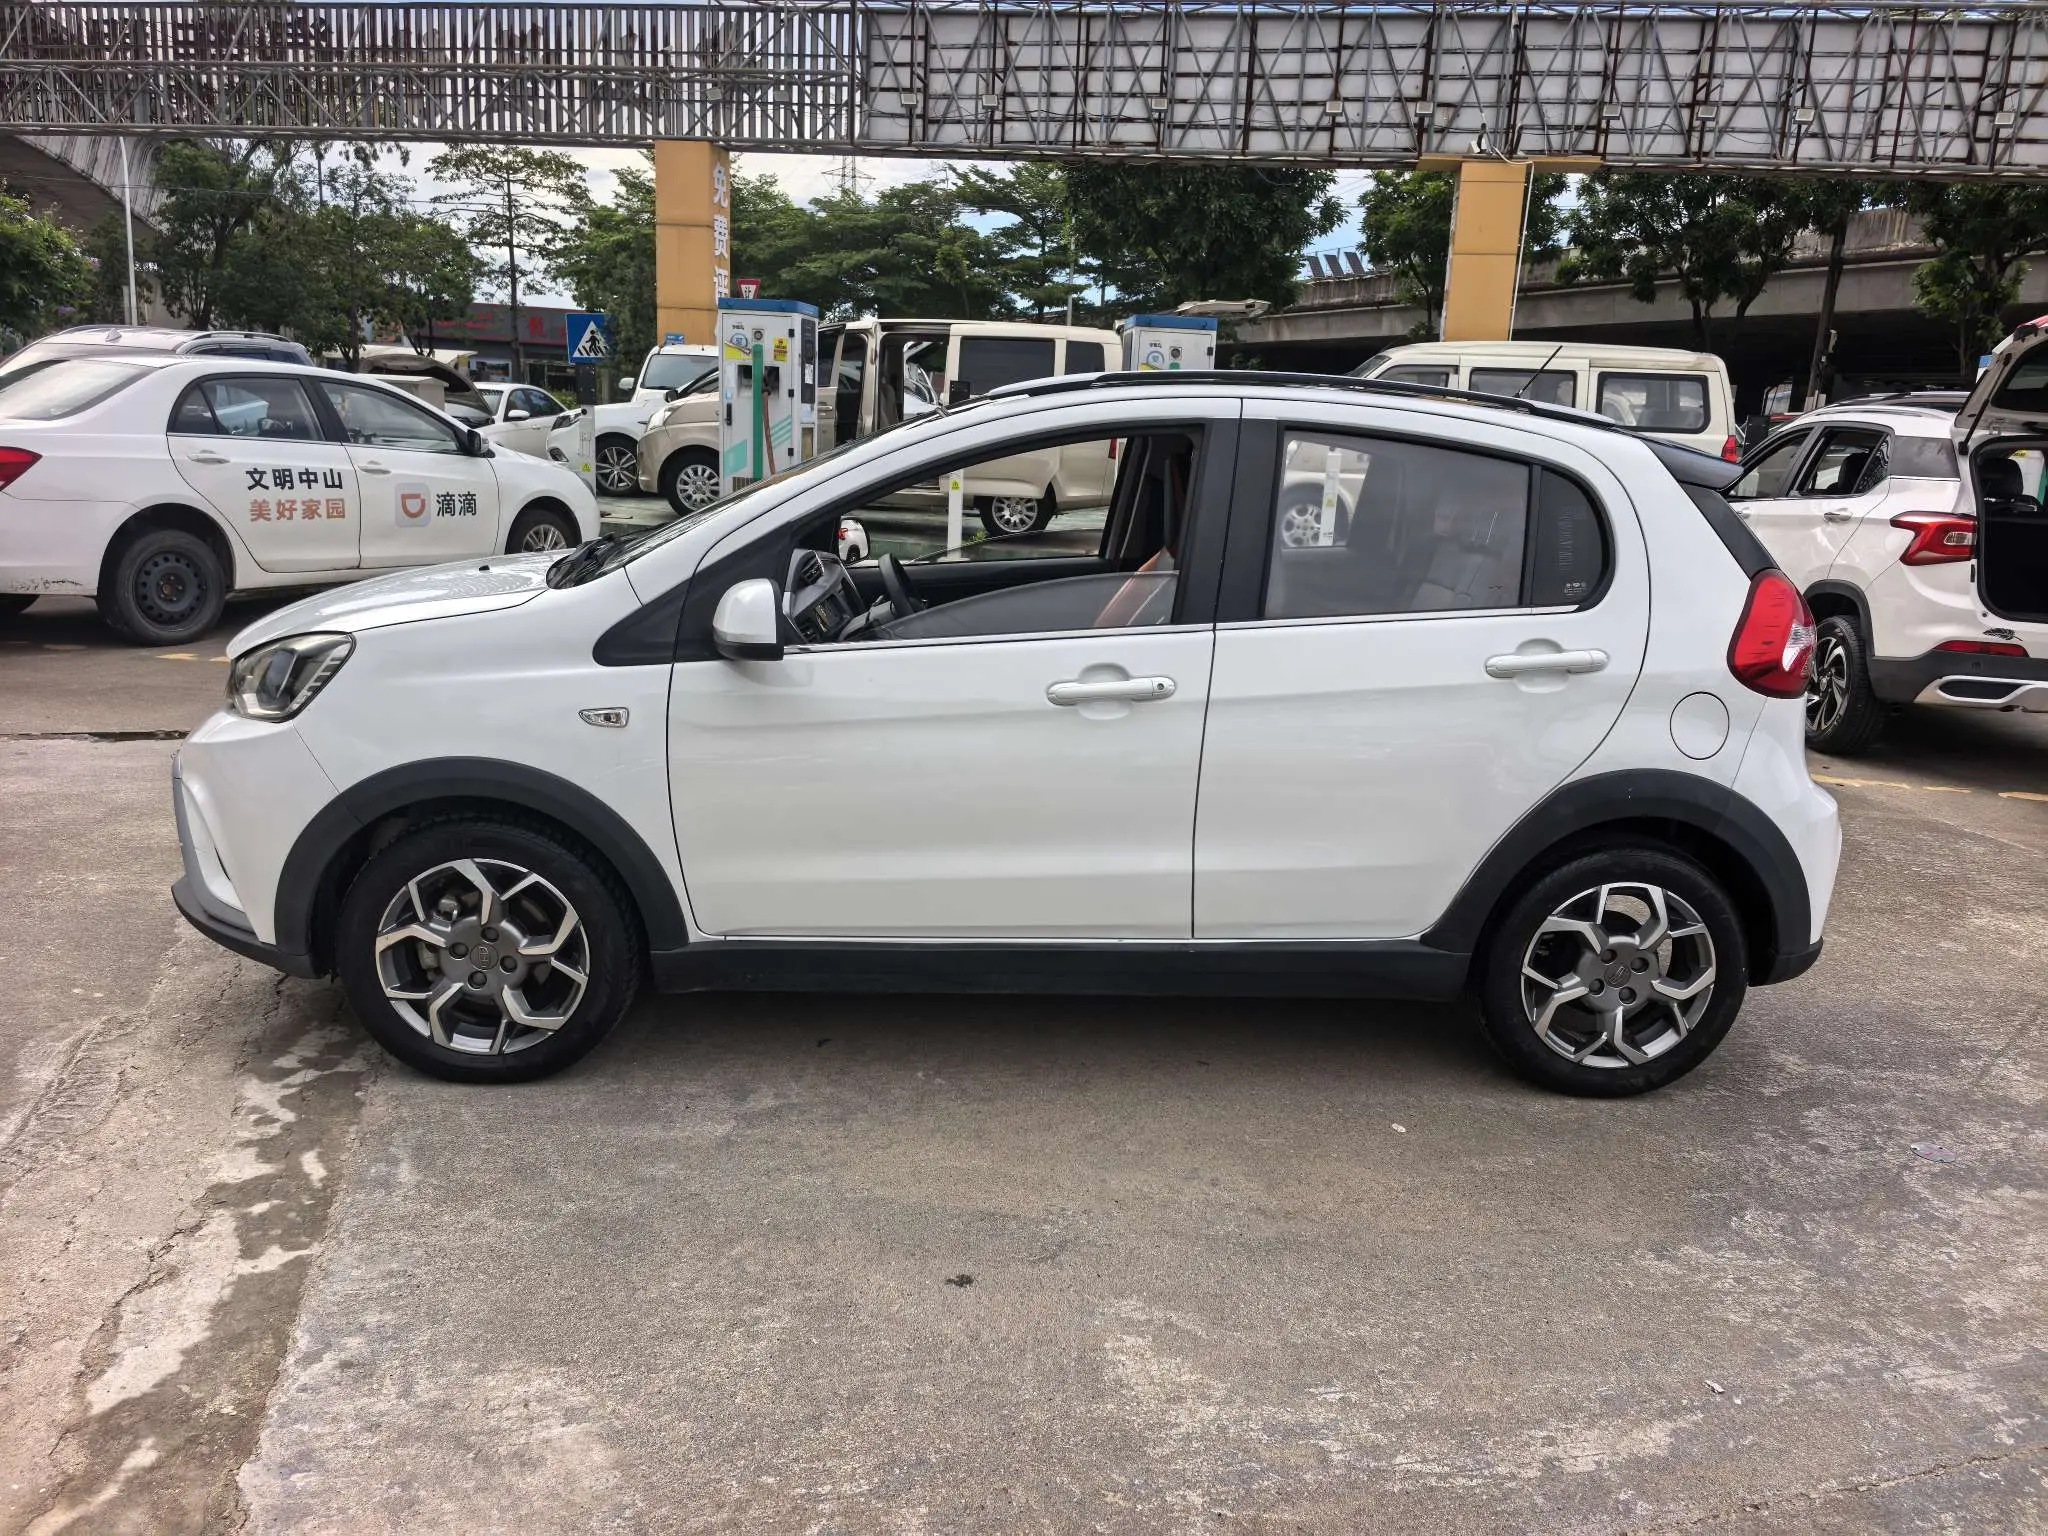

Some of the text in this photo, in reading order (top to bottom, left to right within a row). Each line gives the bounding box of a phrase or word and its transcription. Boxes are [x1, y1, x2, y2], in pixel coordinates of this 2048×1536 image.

[713, 161, 729, 337] 免费评
[246, 467, 343, 490] 文明中山
[249, 498, 346, 522] 美好家园
[436, 491, 477, 517] 滴滴
